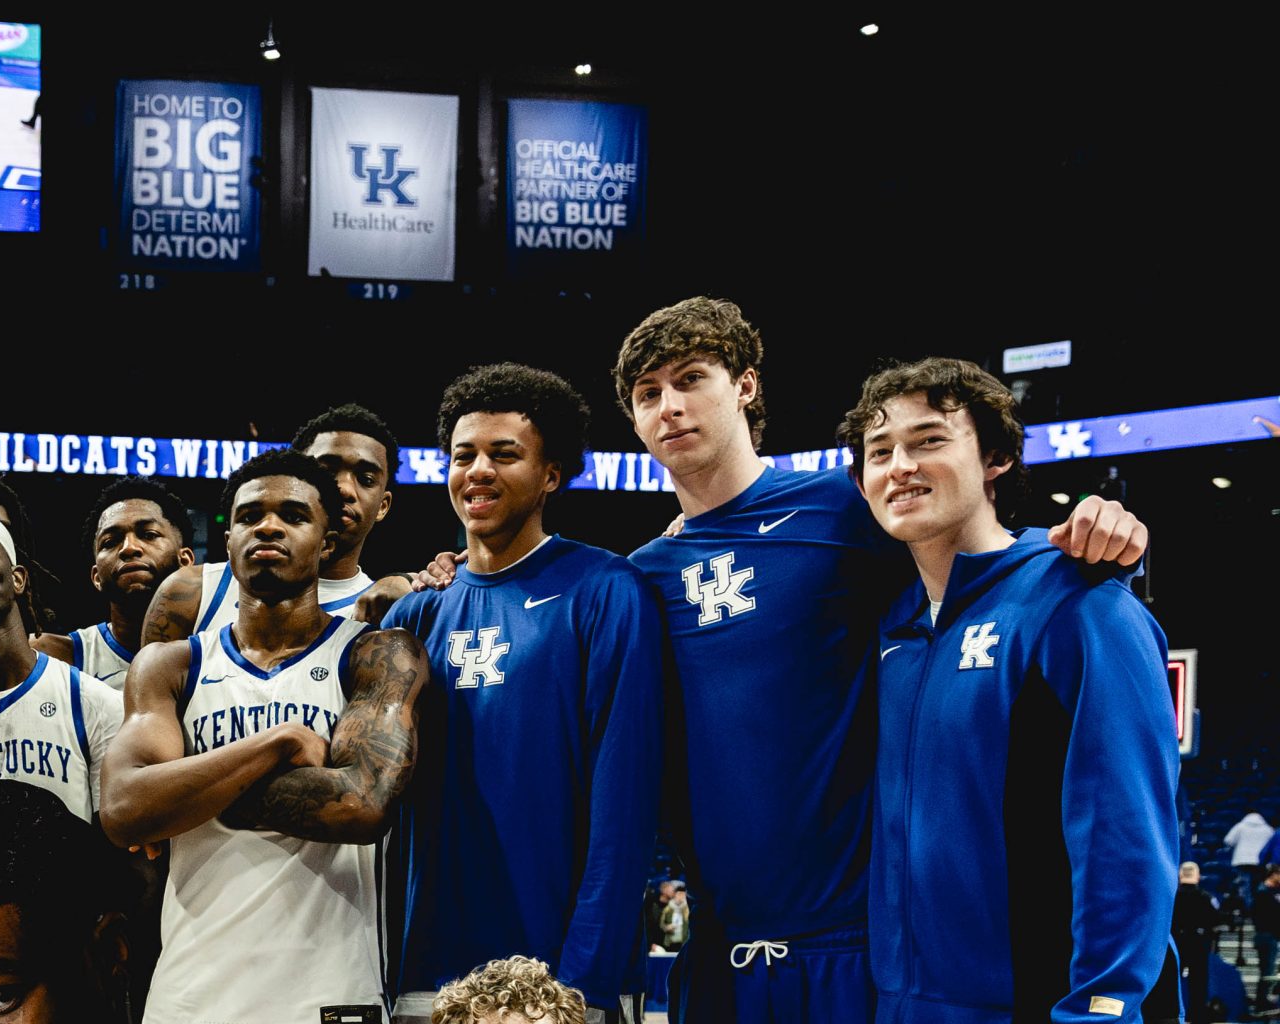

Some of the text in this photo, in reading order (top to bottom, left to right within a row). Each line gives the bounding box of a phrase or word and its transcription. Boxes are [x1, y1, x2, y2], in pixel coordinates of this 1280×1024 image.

[134, 94, 243, 119] HOME TO
[133, 117, 241, 173] BIG
[516, 139, 600, 160] OFFICIAL
[347, 143, 418, 207] UK
[516, 159, 637, 182] HEALTHCARE
[133, 170, 240, 209] BLUE
[516, 179, 629, 201] PARTNER OF
[132, 208, 240, 234] DETERMI
[332, 211, 435, 234] HealthCare
[516, 200, 627, 226] BIG BLUE
[516, 225, 613, 250] NATION
[363, 283, 398, 299] 219
[681, 551, 756, 627] UK
[447, 626, 510, 690] UK
[958, 621, 1000, 670] UK
